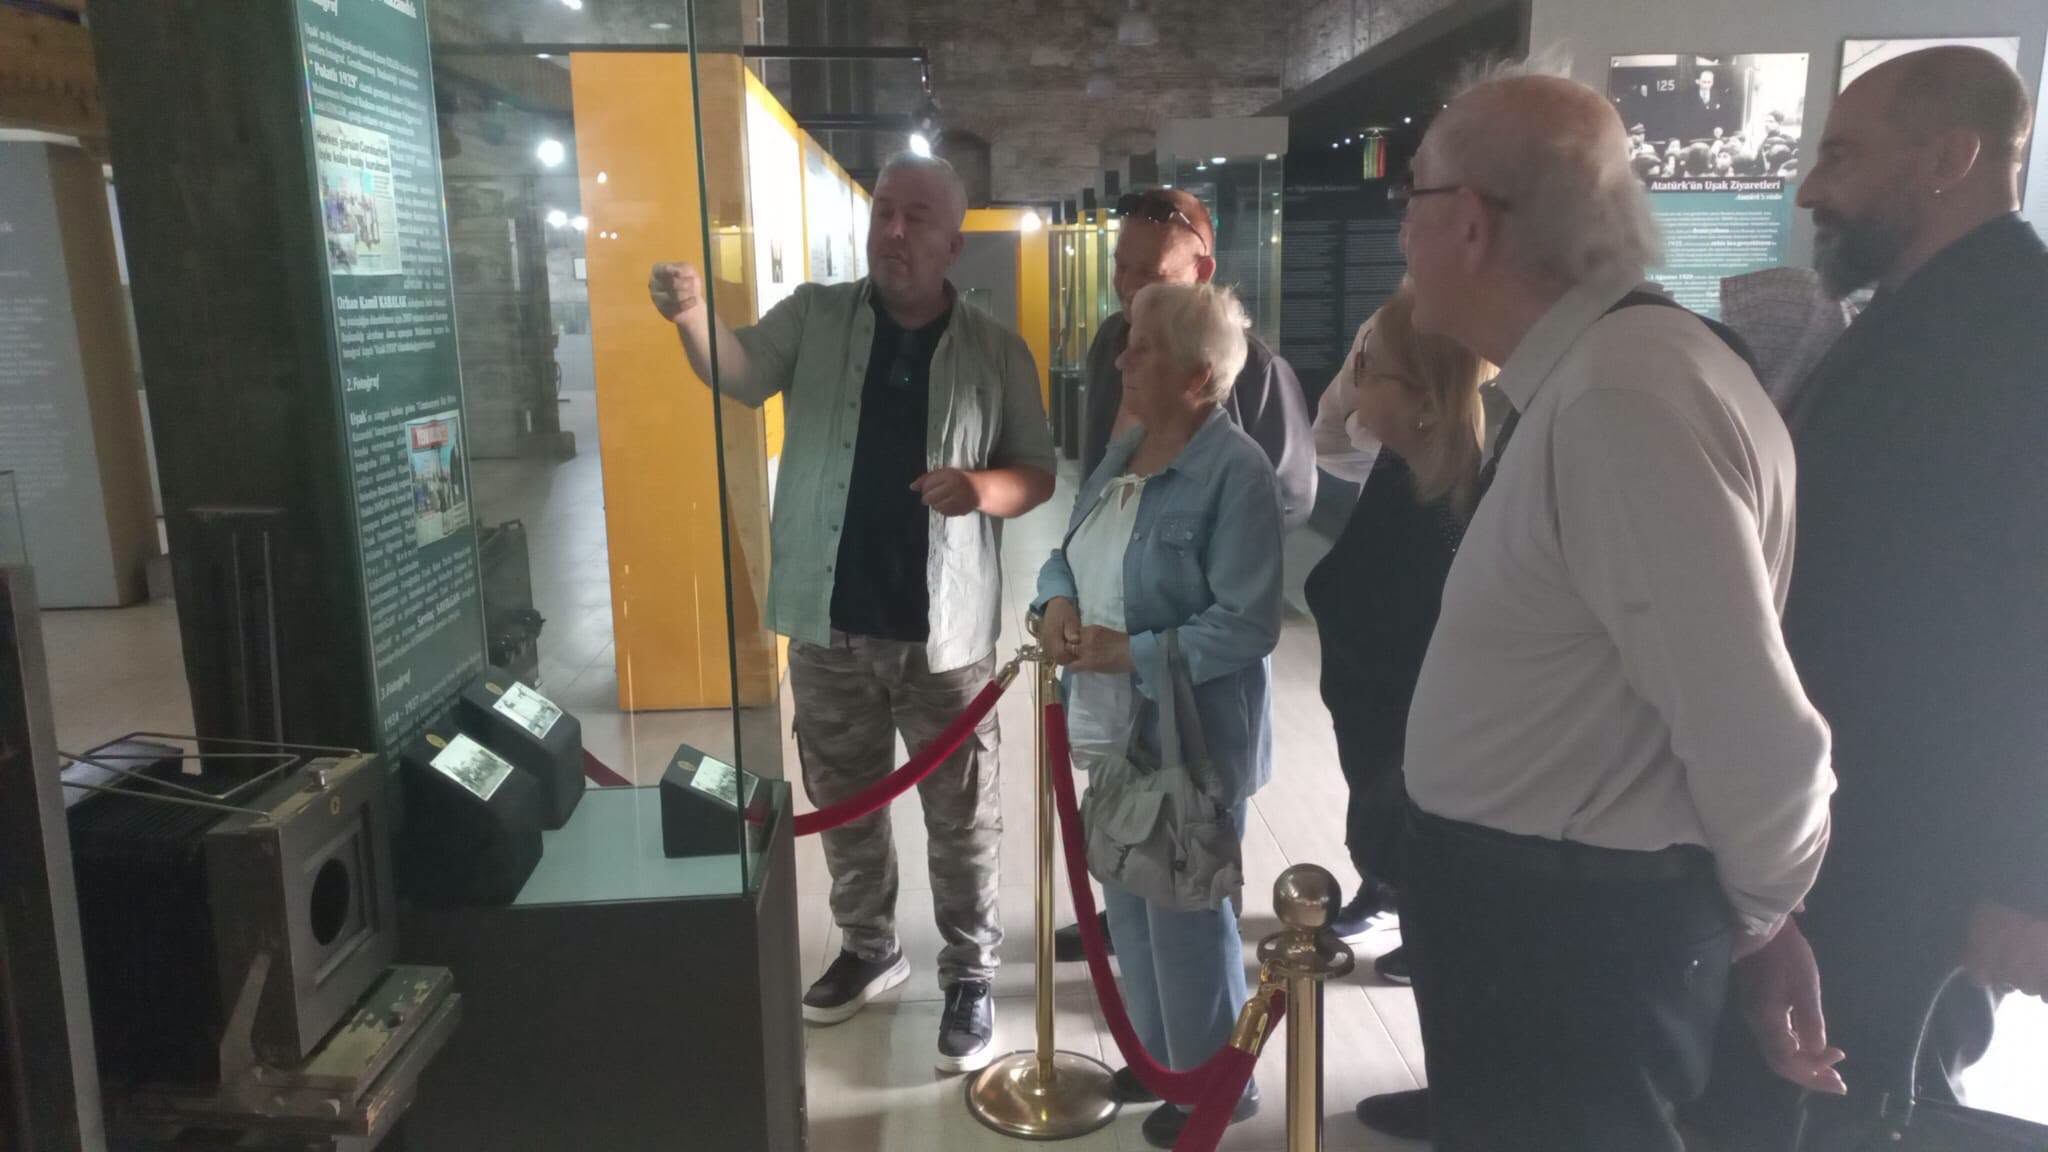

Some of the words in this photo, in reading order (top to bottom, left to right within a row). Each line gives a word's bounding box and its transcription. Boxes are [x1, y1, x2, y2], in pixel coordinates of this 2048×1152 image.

[1656, 79, 1675, 92] 125
[1651, 180, 1703, 191] Atatürk'ün
[1704, 180, 1729, 192] Uşak
[1730, 180, 1781, 192] Ziyaretleri
